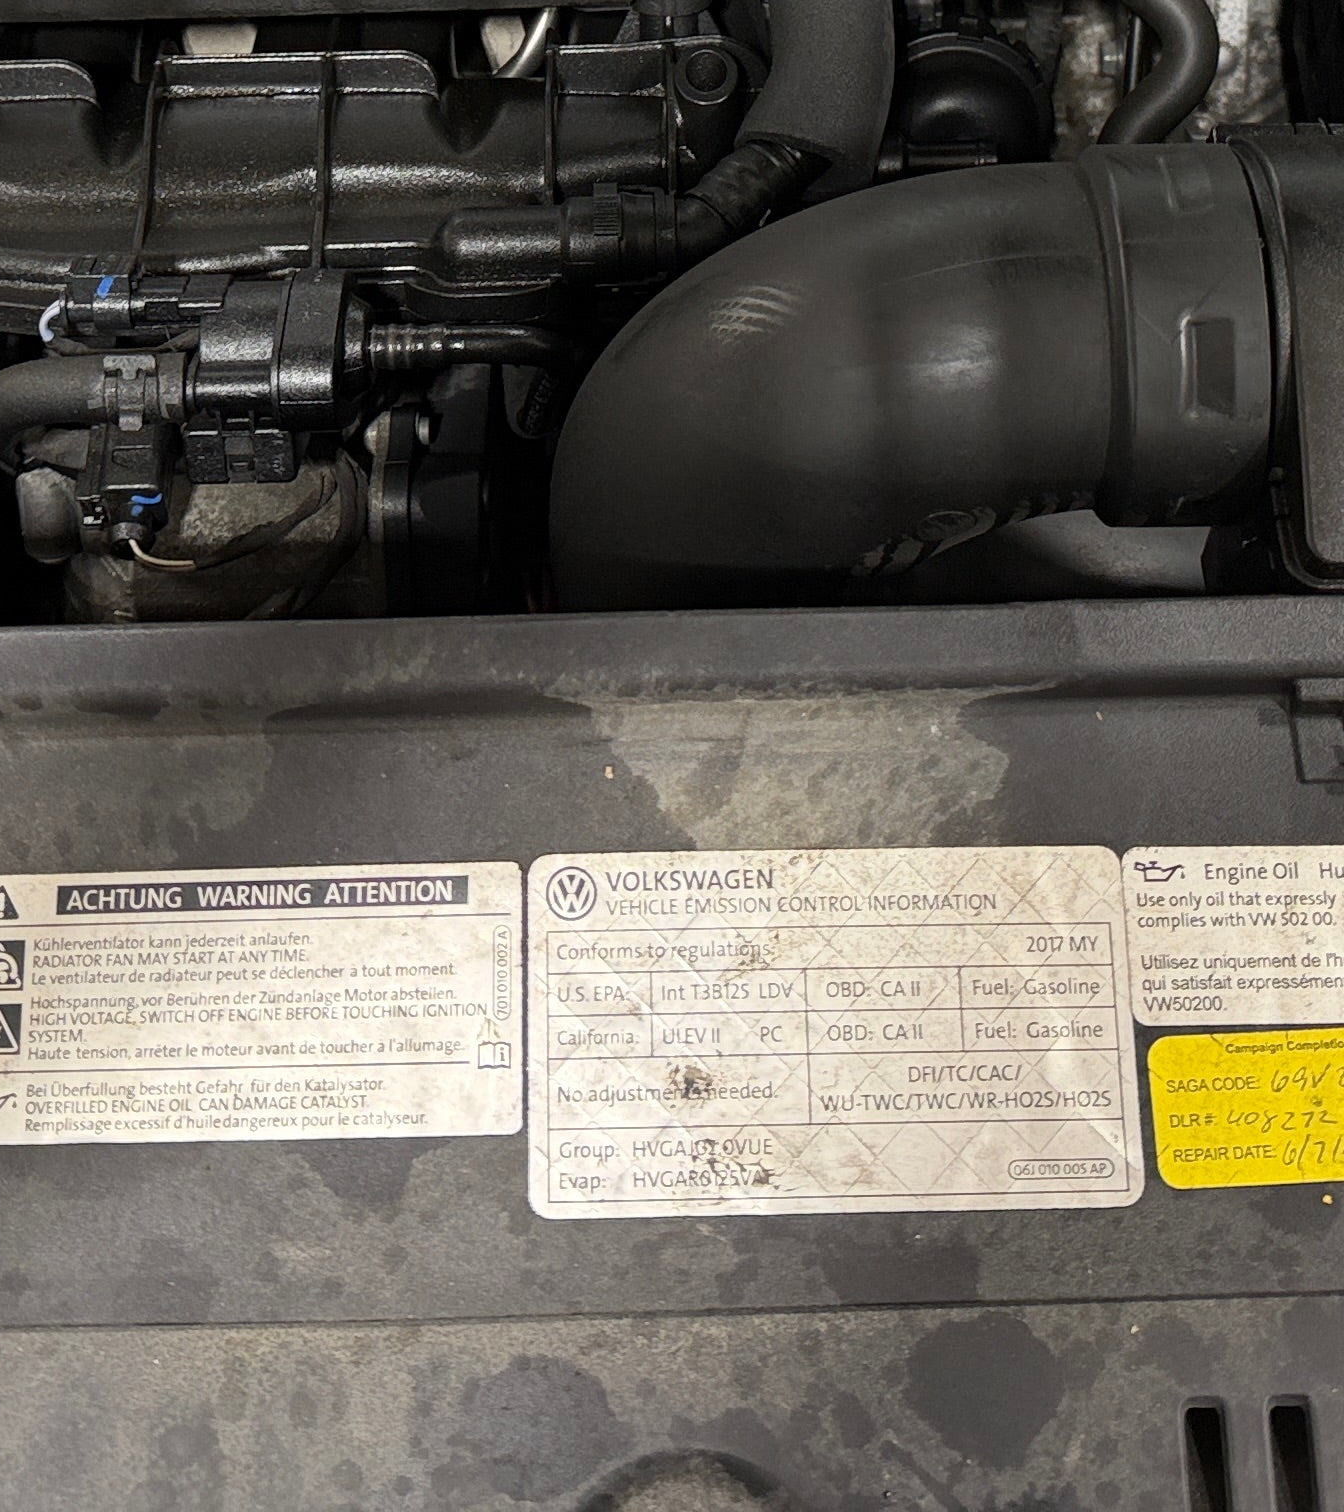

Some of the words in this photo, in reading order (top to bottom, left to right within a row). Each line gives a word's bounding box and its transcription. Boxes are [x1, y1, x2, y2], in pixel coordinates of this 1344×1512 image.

[606, 870, 774, 892] VOLKSWAGEN
[1205, 863, 1268, 885] Engine
[1273, 862, 1299, 879] Oil
[67, 885, 182, 912] ACHTUNG
[197, 883, 311, 908] WARNING
[324, 879, 453, 905] ATTENTION
[606, 897, 681, 916] VEHICLE
[687, 896, 771, 914] EMISSION
[778, 894, 862, 913] CONTROL
[868, 892, 996, 912] INFORMATION
[1137, 892, 1165, 907] Use
[1169, 891, 1202, 911] only
[1206, 892, 1225, 906] oil
[1229, 891, 1261, 906] that
[1266, 891, 1336, 912] expressly
[1138, 914, 1206, 932] complies
[1210, 913, 1245, 927] with
[1249, 912, 1276, 926] VW
[1281, 912, 1307, 926] 502
[557, 943, 642, 961] Conforms
[648, 946, 667, 958] to
[1026, 936, 1063, 953] 2017
[1070, 936, 1098, 951] MY
[33, 954, 101, 968] RADIATOR
[106, 953, 133, 967] FAN
[138, 953, 168, 965] MAY
[173, 951, 213, 964] START
[218, 951, 235, 963] AT
[239, 950, 267, 963] ANY
[1141, 954, 1199, 970] Utilisez
[1204, 951, 1296, 971] uniquement
[1301, 953, 1321, 968] de
[662, 985, 685, 1001] Int
[759, 982, 793, 998] LDV
[826, 981, 872, 998] OBD:
[881, 981, 905, 996] CA
[972, 978, 1014, 996] Fuel:
[1024, 977, 1100, 995] Gasoline
[1142, 975, 1166, 994] qui
[1171, 973, 1232, 990] satisfait
[30, 1013, 66, 1026] HIGH
[140, 1010, 195, 1024] SWITCH
[199, 1009, 224, 1022] OFF
[228, 1007, 281, 1022] ENGINE
[286, 1006, 338, 1020] BEFORE
[342, 1005, 418, 1019] TOUCHING
[423, 1003, 487, 1017] IGNITION
[663, 1028, 706, 1044] ULEV
[760, 1026, 782, 1042] PC
[827, 1024, 873, 1042] OBD:
[883, 1024, 907, 1040] CA
[976, 1021, 1016, 1038] Fuel:
[1026, 1020, 1104, 1038] Gasoline
[1225, 1043, 1283, 1055] Campaign
[558, 1086, 582, 1103] No
[1166, 1079, 1209, 1093] SAGA
[25, 1099, 107, 1115] OVERFILLED
[111, 1099, 165, 1113] ENGINE
[169, 1098, 193, 1111] OIL
[199, 1098, 229, 1111] CAN
[233, 1096, 296, 1110] DAMAGE
[1170, 1114, 1200, 1128] DLR
[559, 1141, 620, 1162] Group:
[1173, 1146, 1228, 1163] REPAIR
[1038, 1164, 1060, 1175] 010
[1064, 1163, 1087, 1174] 005
[1090, 1163, 1106, 1174] AP
[559, 1172, 606, 1193] Evap:
